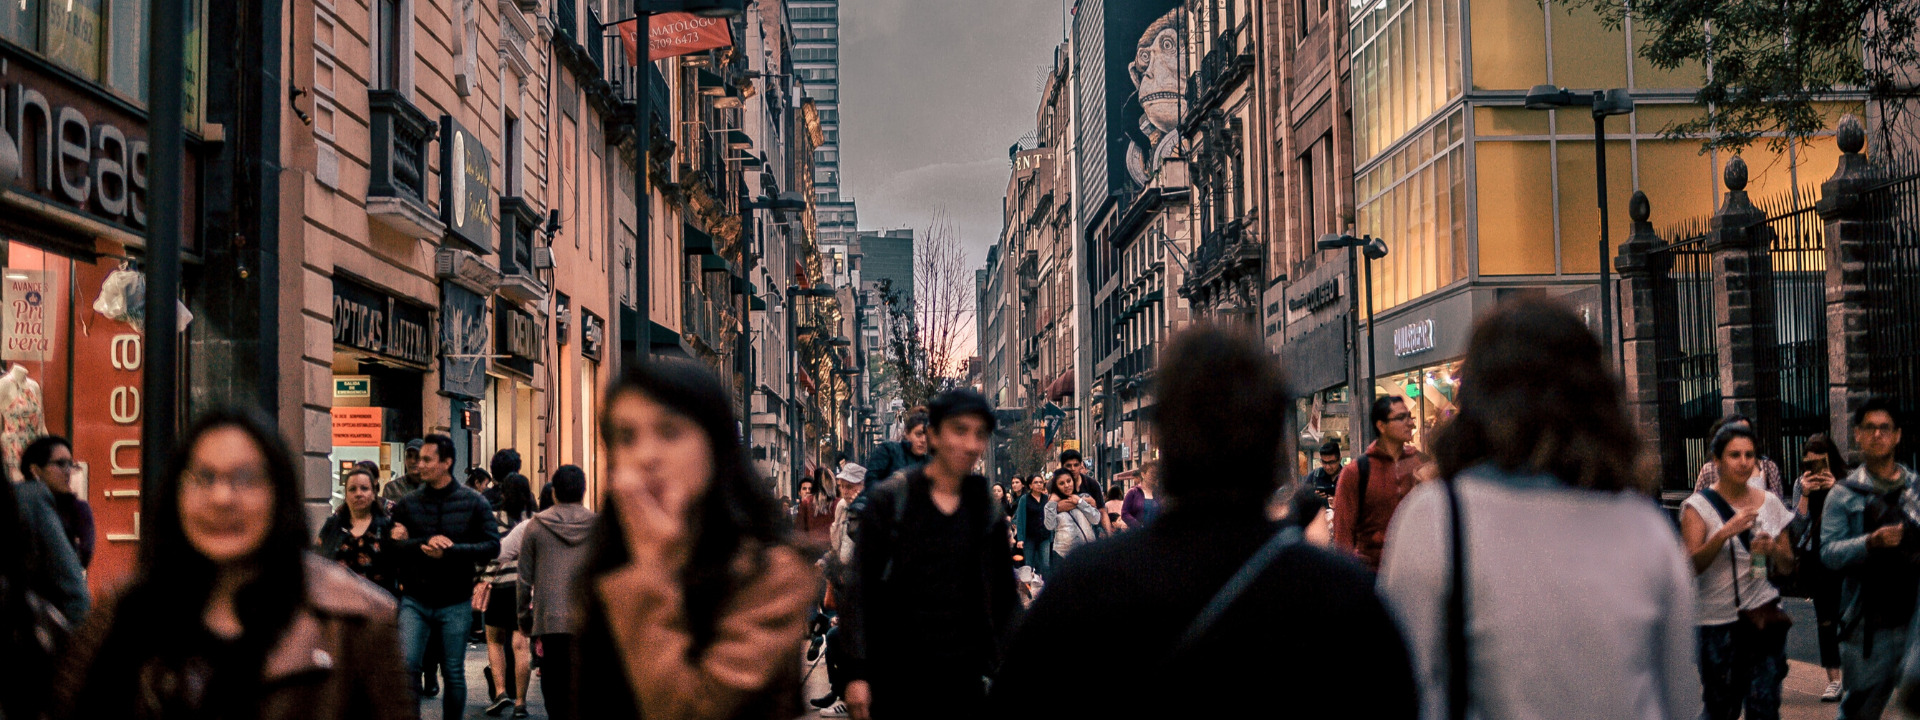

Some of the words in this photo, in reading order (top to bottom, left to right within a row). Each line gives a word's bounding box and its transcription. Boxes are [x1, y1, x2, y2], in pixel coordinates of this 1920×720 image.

[649, 37, 672, 51] 5709
[674, 31, 699, 45] 6473
[12, 281, 48, 293] AVANCES
[15, 321, 43, 335] ma
[333, 294, 383, 351] OPTICAS
[8, 336, 48, 351] vera
